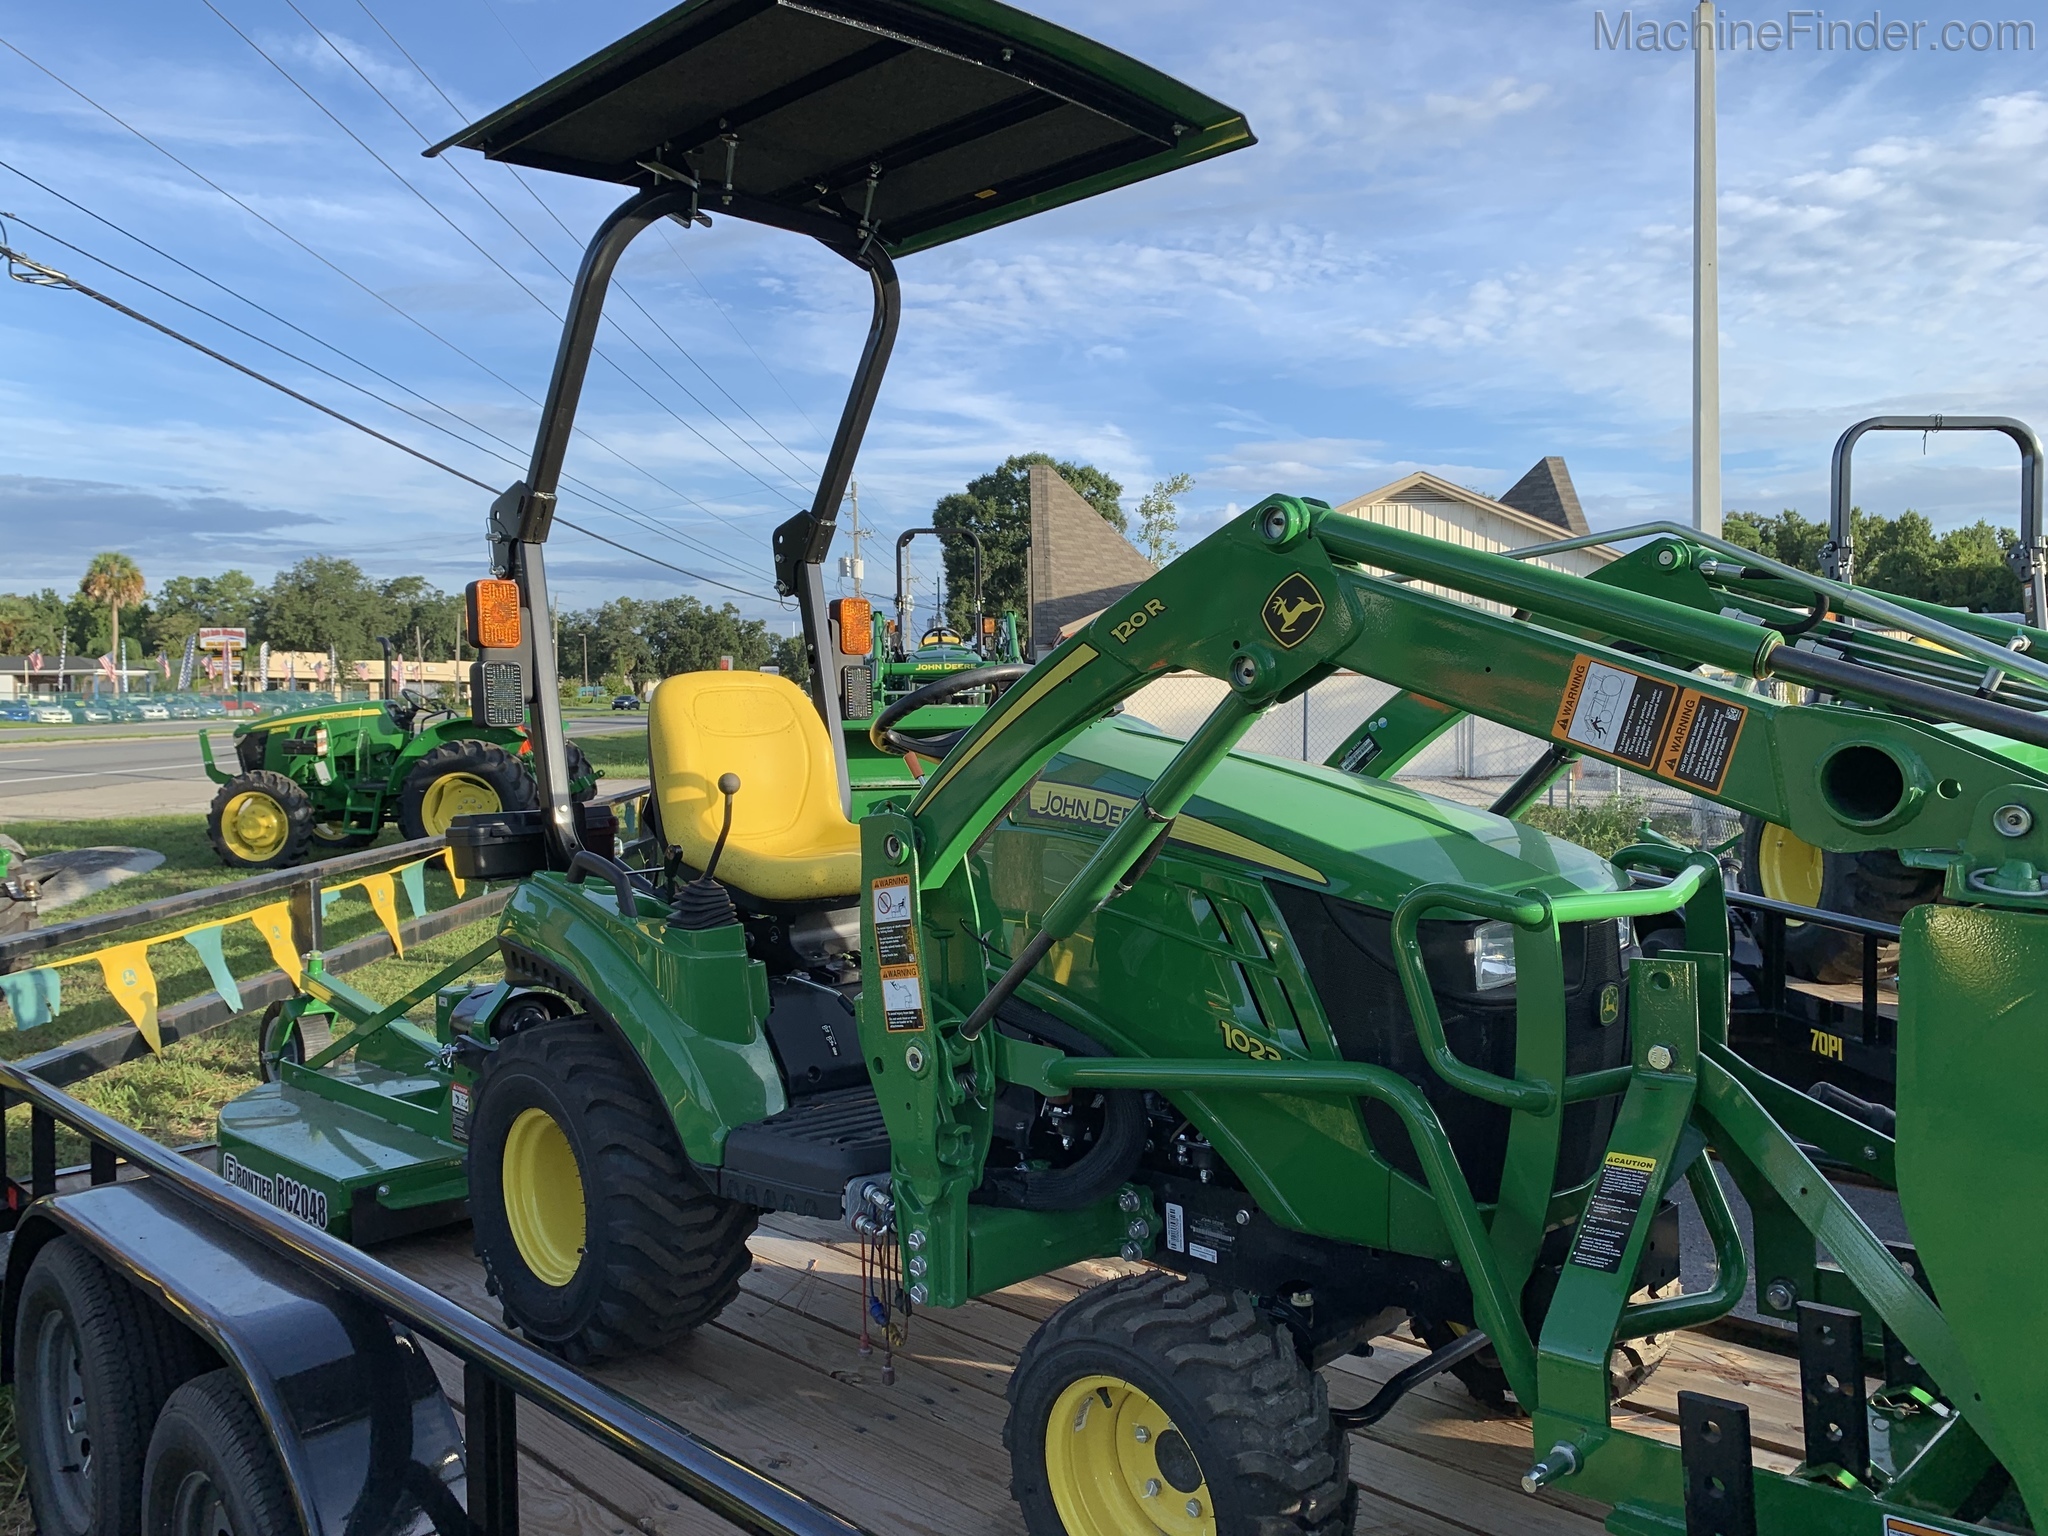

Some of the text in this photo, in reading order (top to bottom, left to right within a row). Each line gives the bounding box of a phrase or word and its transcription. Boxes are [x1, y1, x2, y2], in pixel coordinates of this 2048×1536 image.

[915, 663, 942, 671] JOHN
[1560, 663, 1586, 717] WARNING
[1669, 698, 1696, 753] WARNING
[1040, 790, 1089, 819] JOHN
[880, 876, 908, 888] WARNING
[887, 968, 917, 979] WARNING
[1614, 1157, 1653, 1169] CAUTION
[277, 1175, 327, 1229] RC2048
